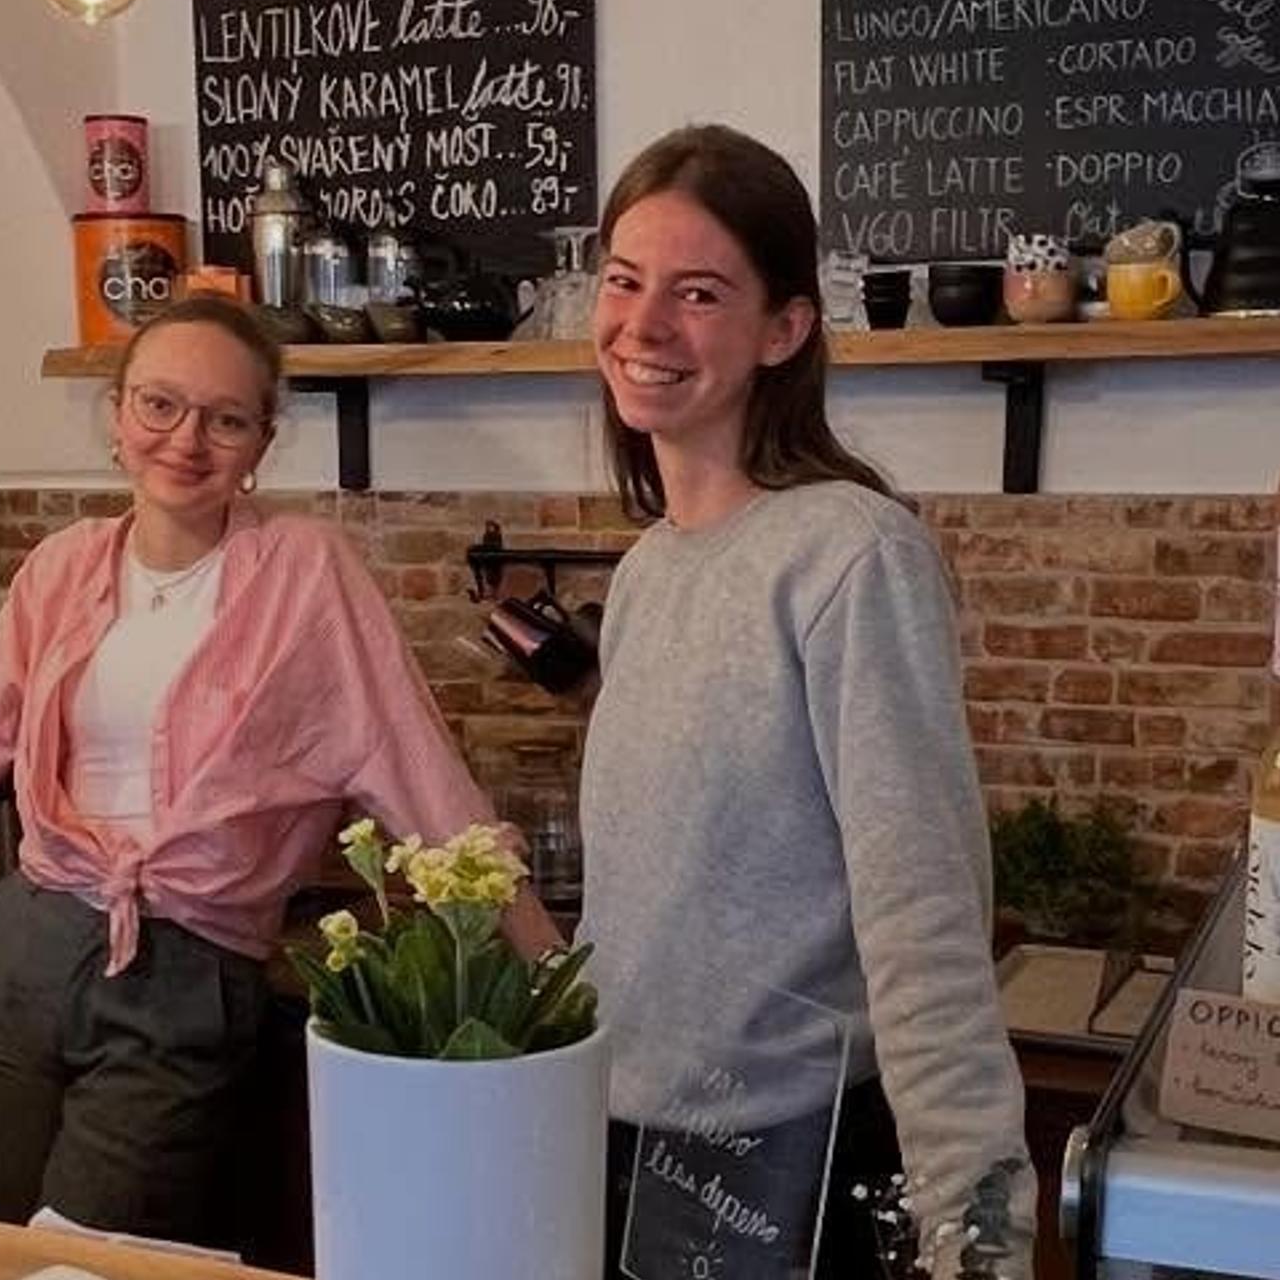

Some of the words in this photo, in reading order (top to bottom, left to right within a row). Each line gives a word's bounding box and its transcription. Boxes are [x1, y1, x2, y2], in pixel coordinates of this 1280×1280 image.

[834, 54, 896, 96] FLAT
[909, 47, 1006, 88] WHITE
[1057, 36, 1197, 75] CORTADO
[320, 65, 462, 118] KARAMEL
[833, 103, 1024, 149] CAPPUCCINO
[925, 156, 1025, 196] LATTE
[1056, 151, 1183, 188] DOPPIO
